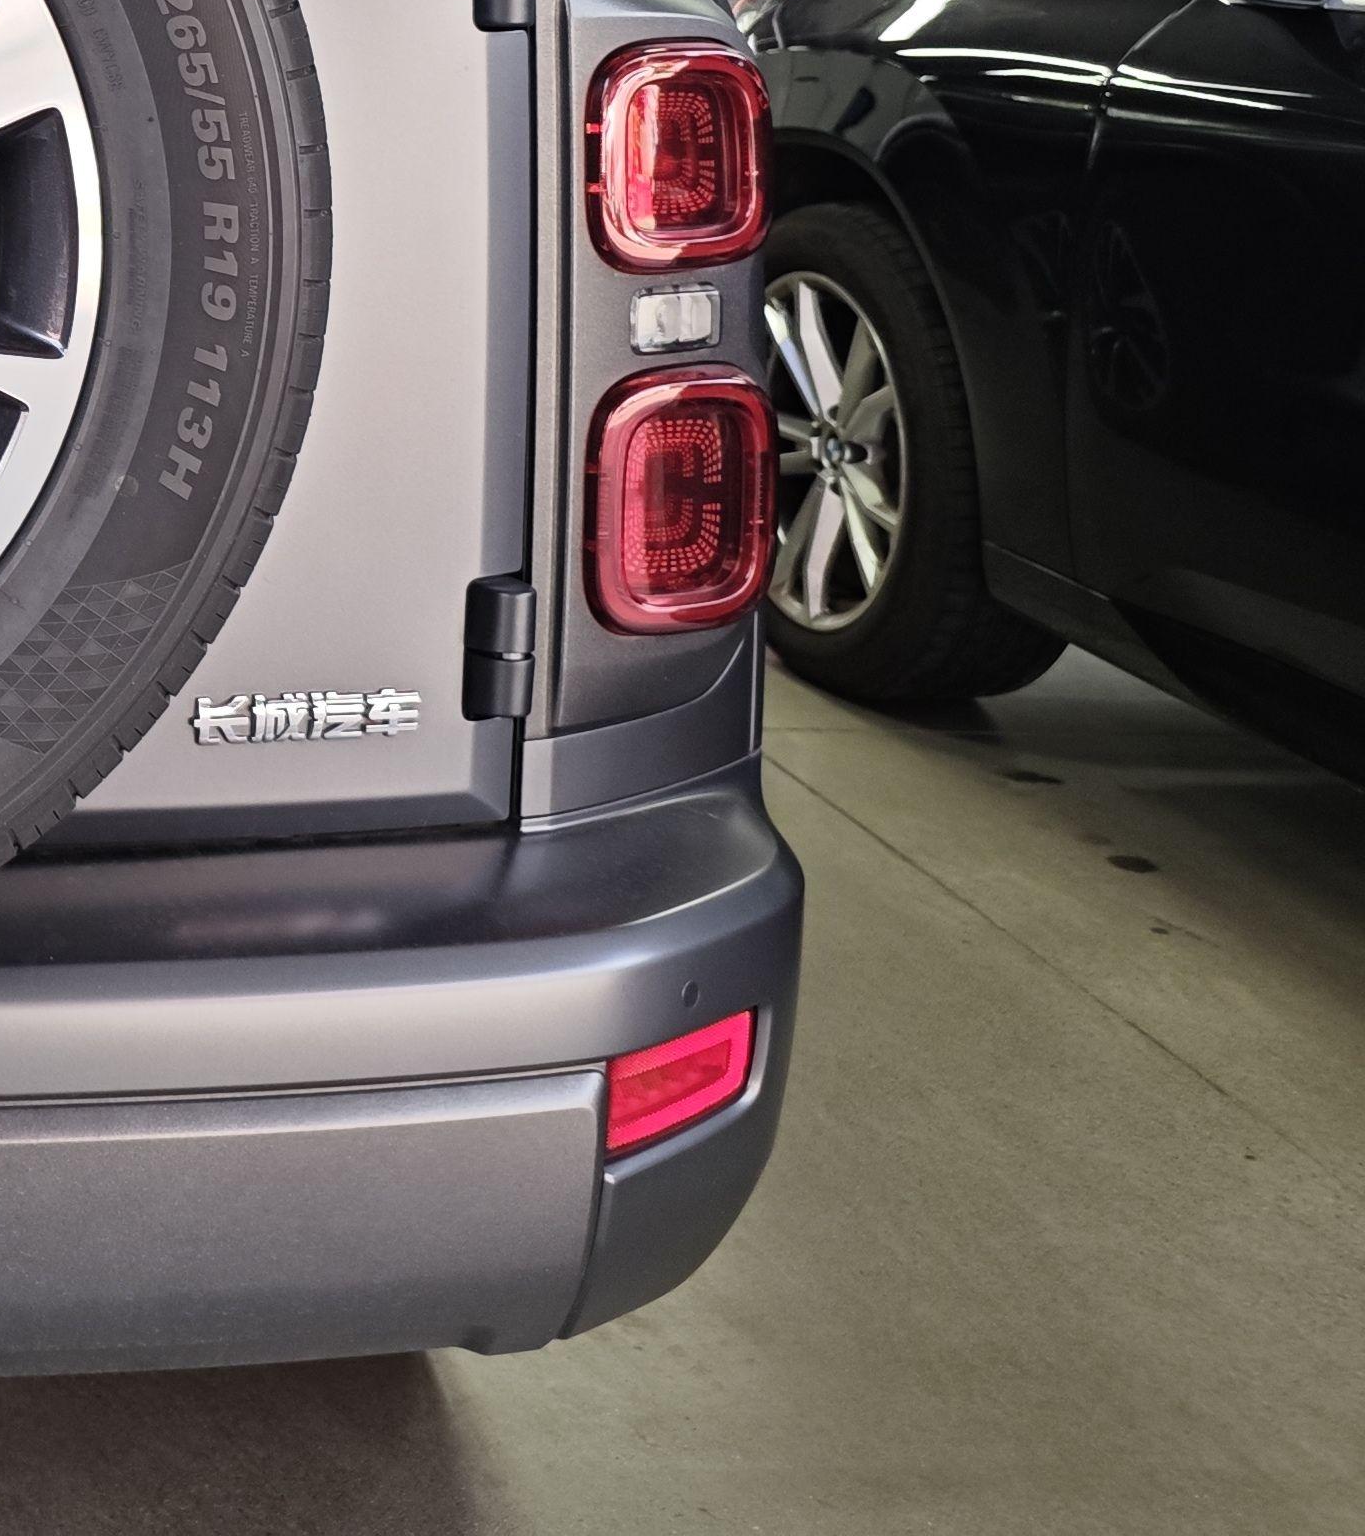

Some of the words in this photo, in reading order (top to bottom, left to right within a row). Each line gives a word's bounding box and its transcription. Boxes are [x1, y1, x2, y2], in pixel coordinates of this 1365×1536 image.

[201, 201, 240, 322] R19
[241, 273, 259, 343] TEMPERATURE
[157, 344, 229, 502] 113H
[189, 688, 421, 744] 长城汽车
